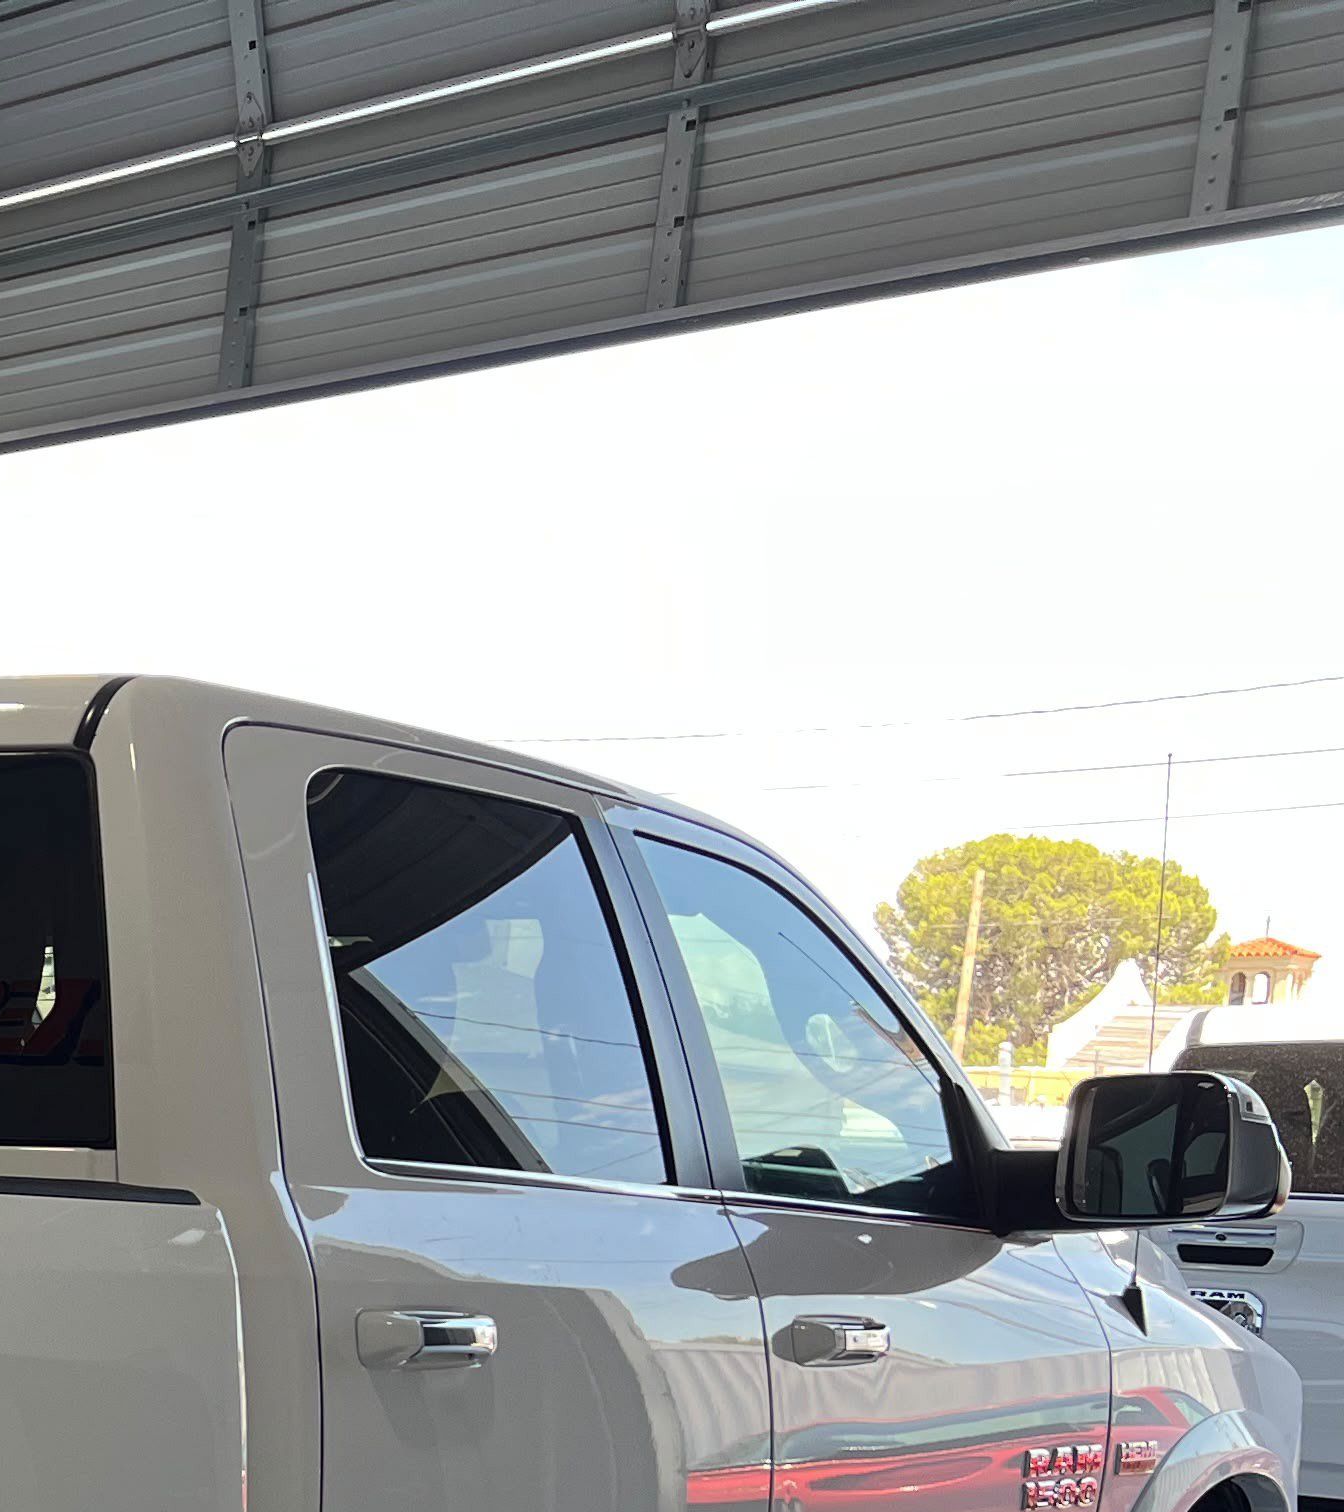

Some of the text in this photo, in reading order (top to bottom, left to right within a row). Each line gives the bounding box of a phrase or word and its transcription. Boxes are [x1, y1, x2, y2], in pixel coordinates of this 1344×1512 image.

[1189, 1290, 1246, 1300] RAM
[1023, 1443, 1103, 1477] RAM
[1021, 1476, 1098, 1512] 1500
